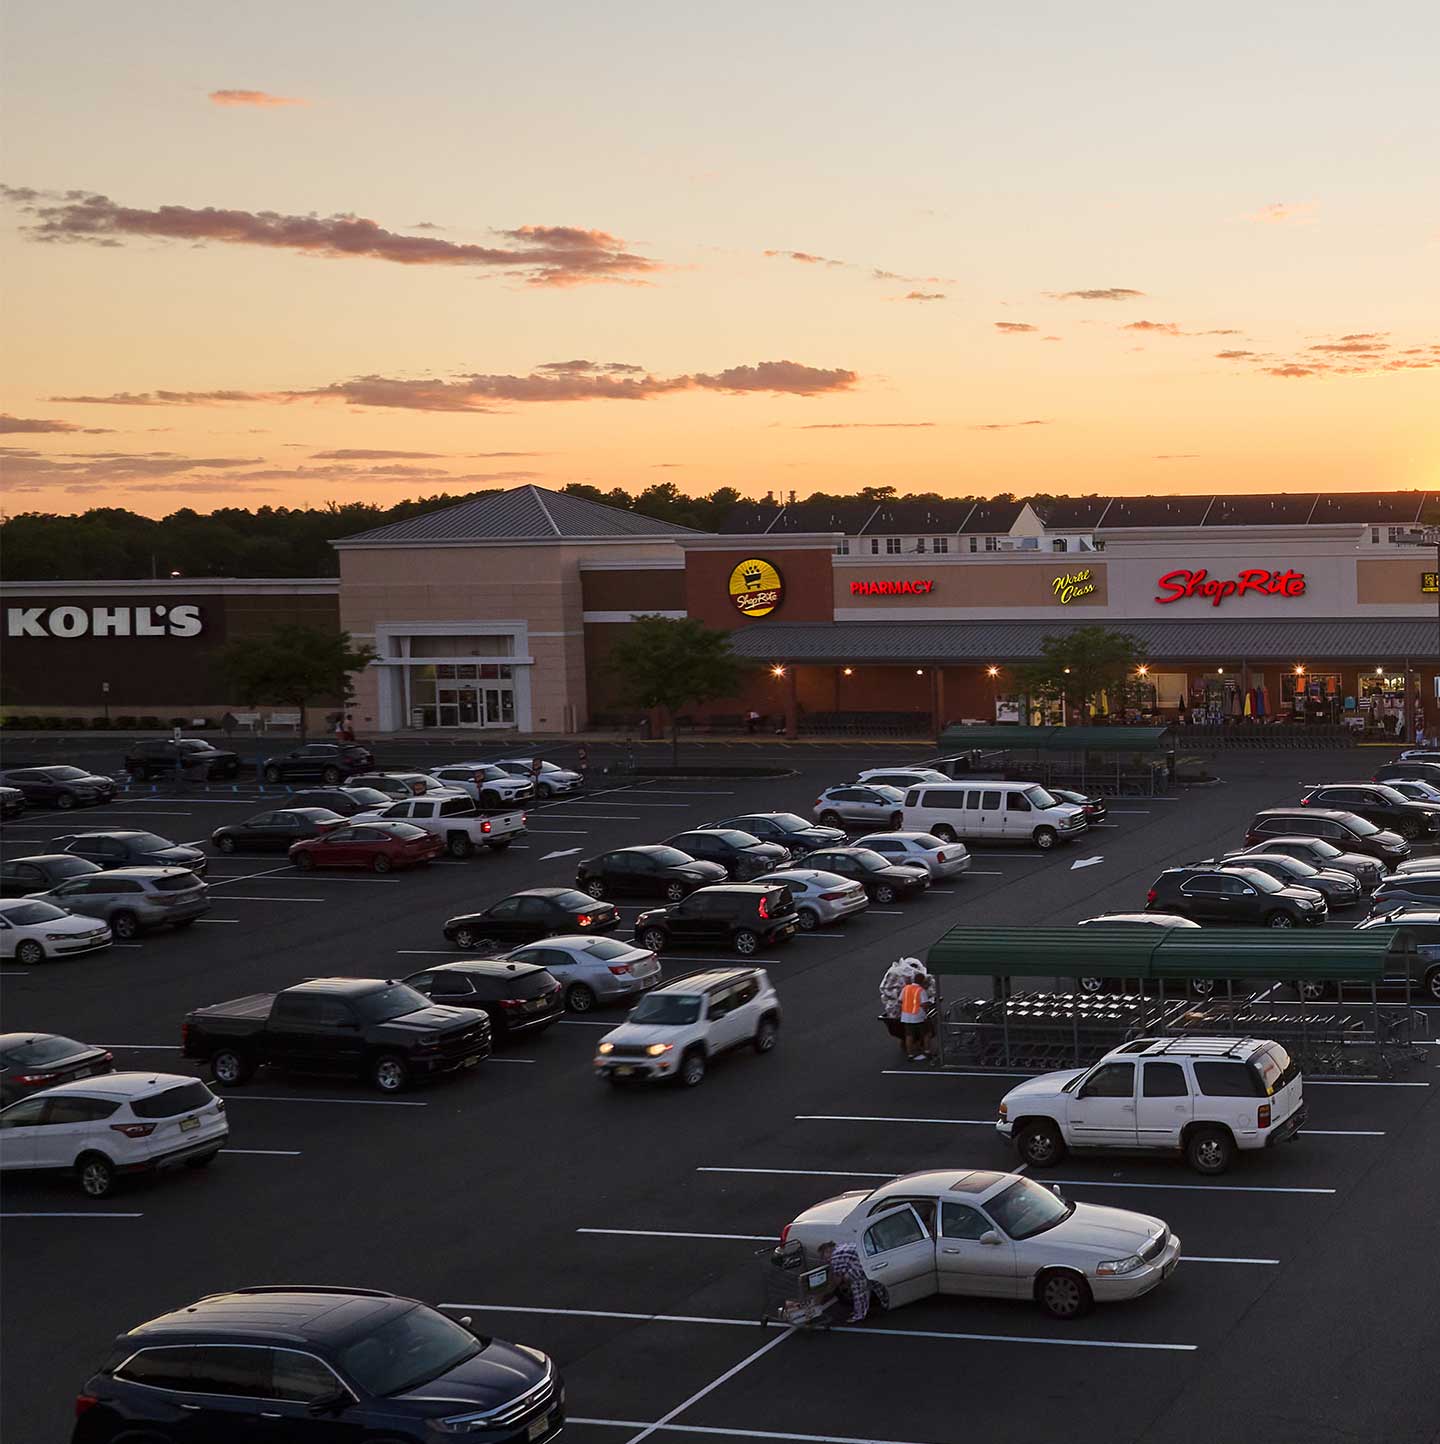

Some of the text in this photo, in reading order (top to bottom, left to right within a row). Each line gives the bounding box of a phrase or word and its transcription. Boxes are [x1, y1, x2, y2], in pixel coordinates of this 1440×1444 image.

[850, 580, 933, 595] PHARMACY
[1051, 569, 1091, 595] World
[1154, 568, 1306, 607] ShopRite
[736, 592, 777, 608] ShopRite
[1060, 585, 1095, 604] Class
[8, 605, 202, 638] KOHL'S
